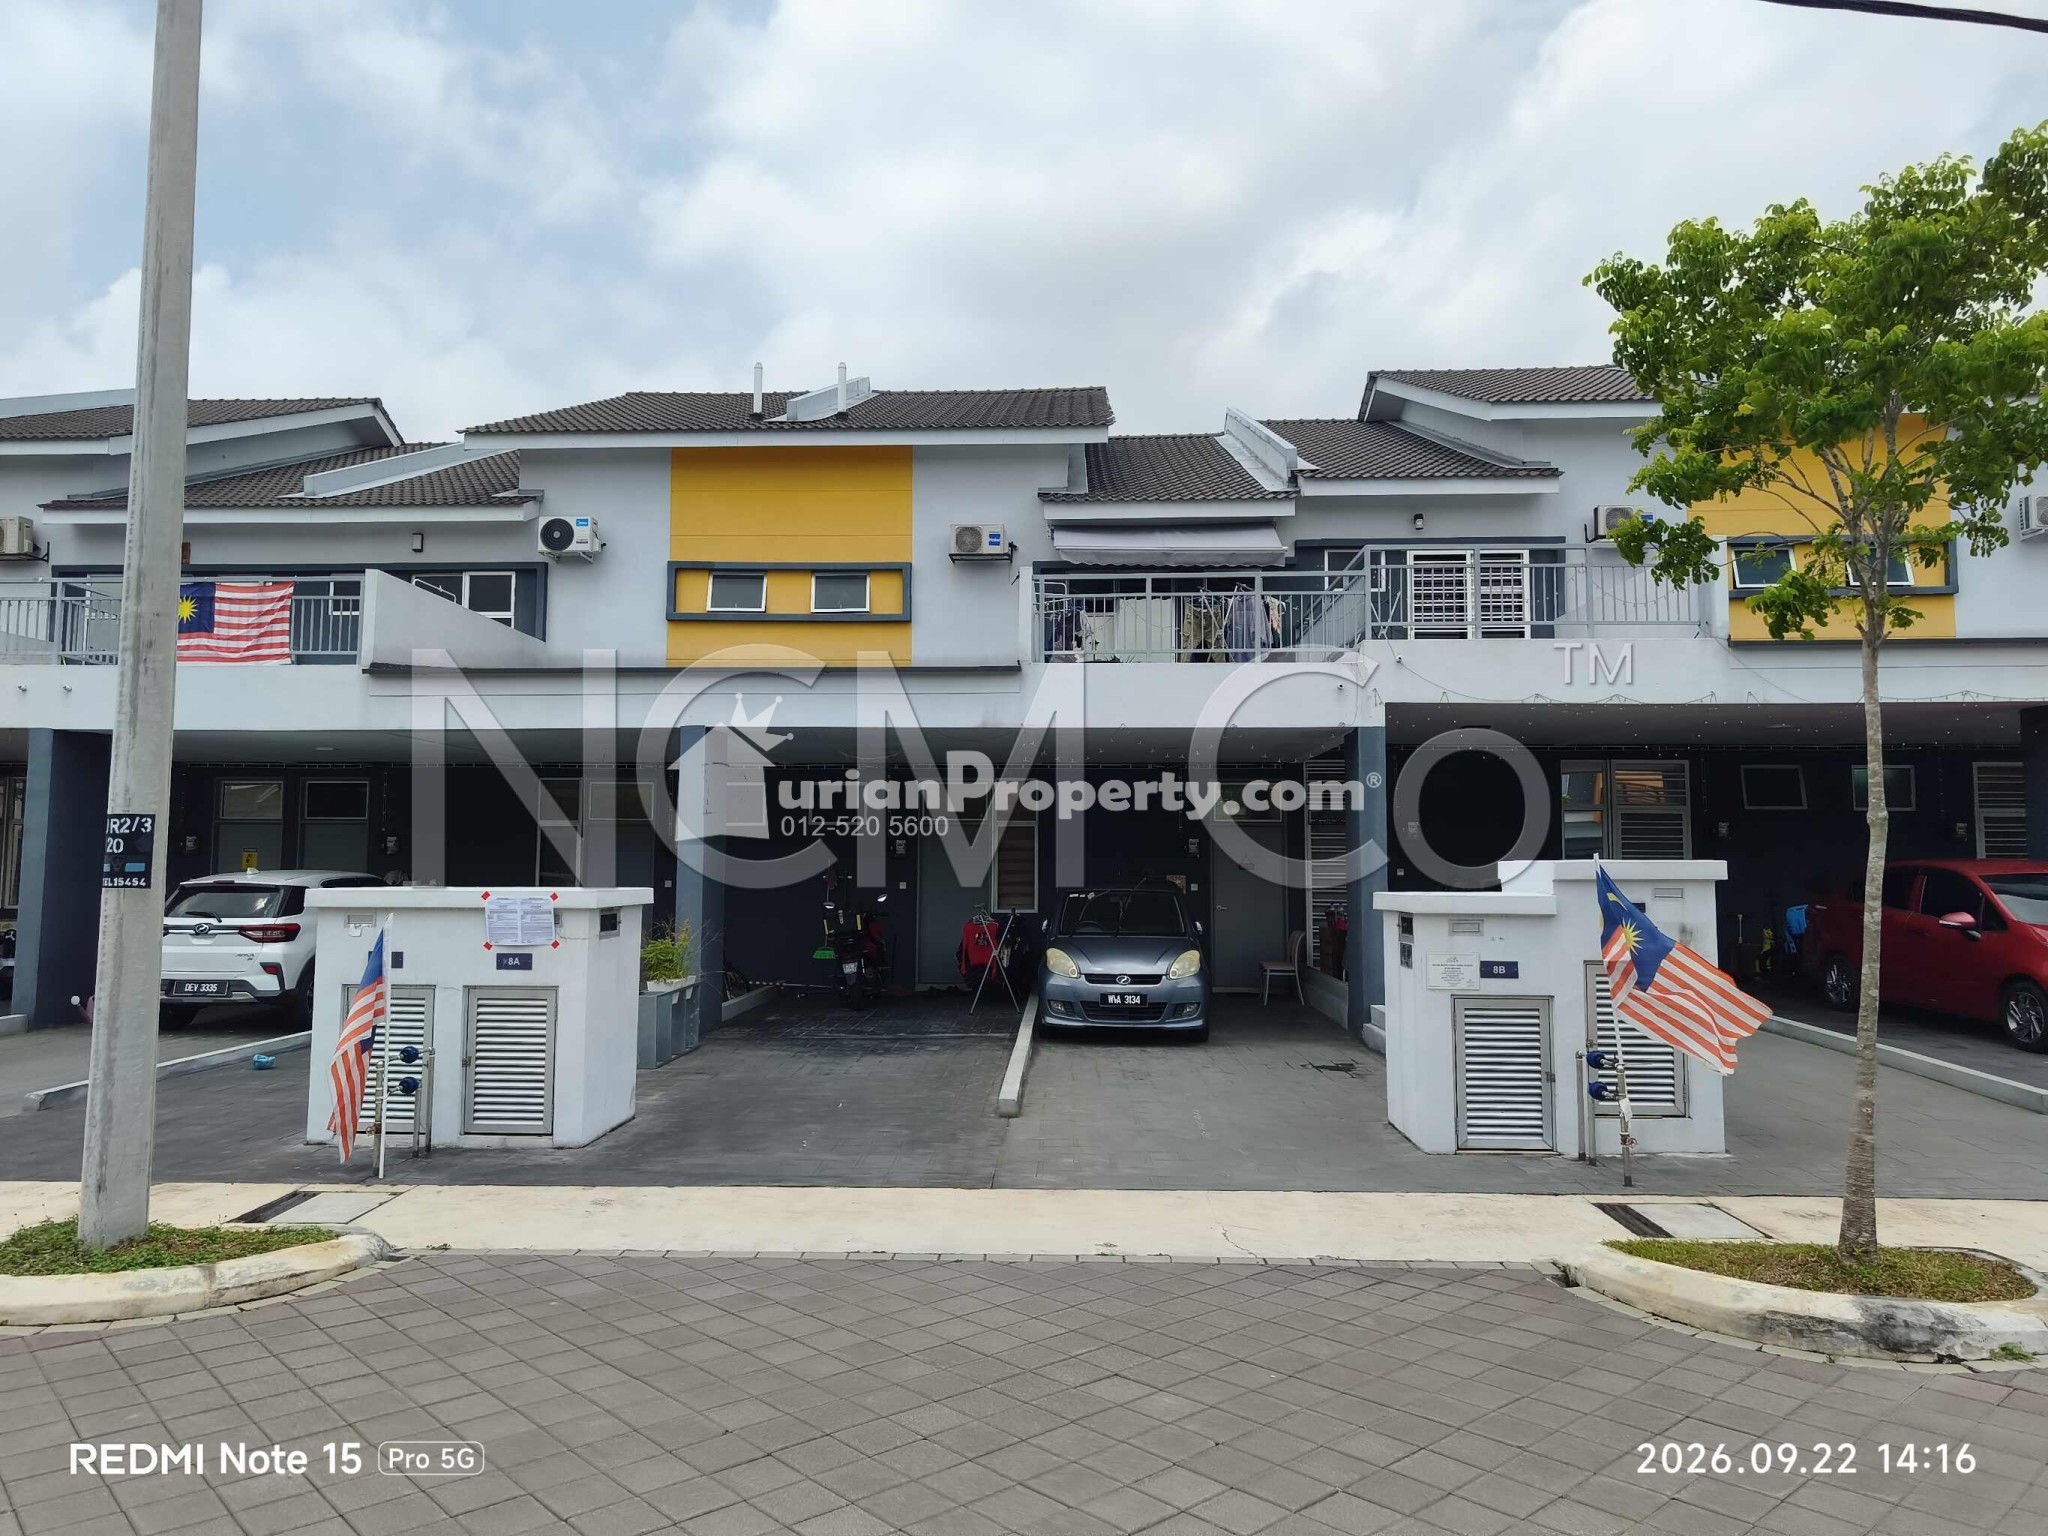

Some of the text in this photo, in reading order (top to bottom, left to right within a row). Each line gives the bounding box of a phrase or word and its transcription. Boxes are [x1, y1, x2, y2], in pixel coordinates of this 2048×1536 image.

[508, 957, 520, 965] 8A
[1493, 965, 1506, 974] 8B
[200, 983, 218, 992] 3335
[1124, 994, 1141, 1004] 3134
